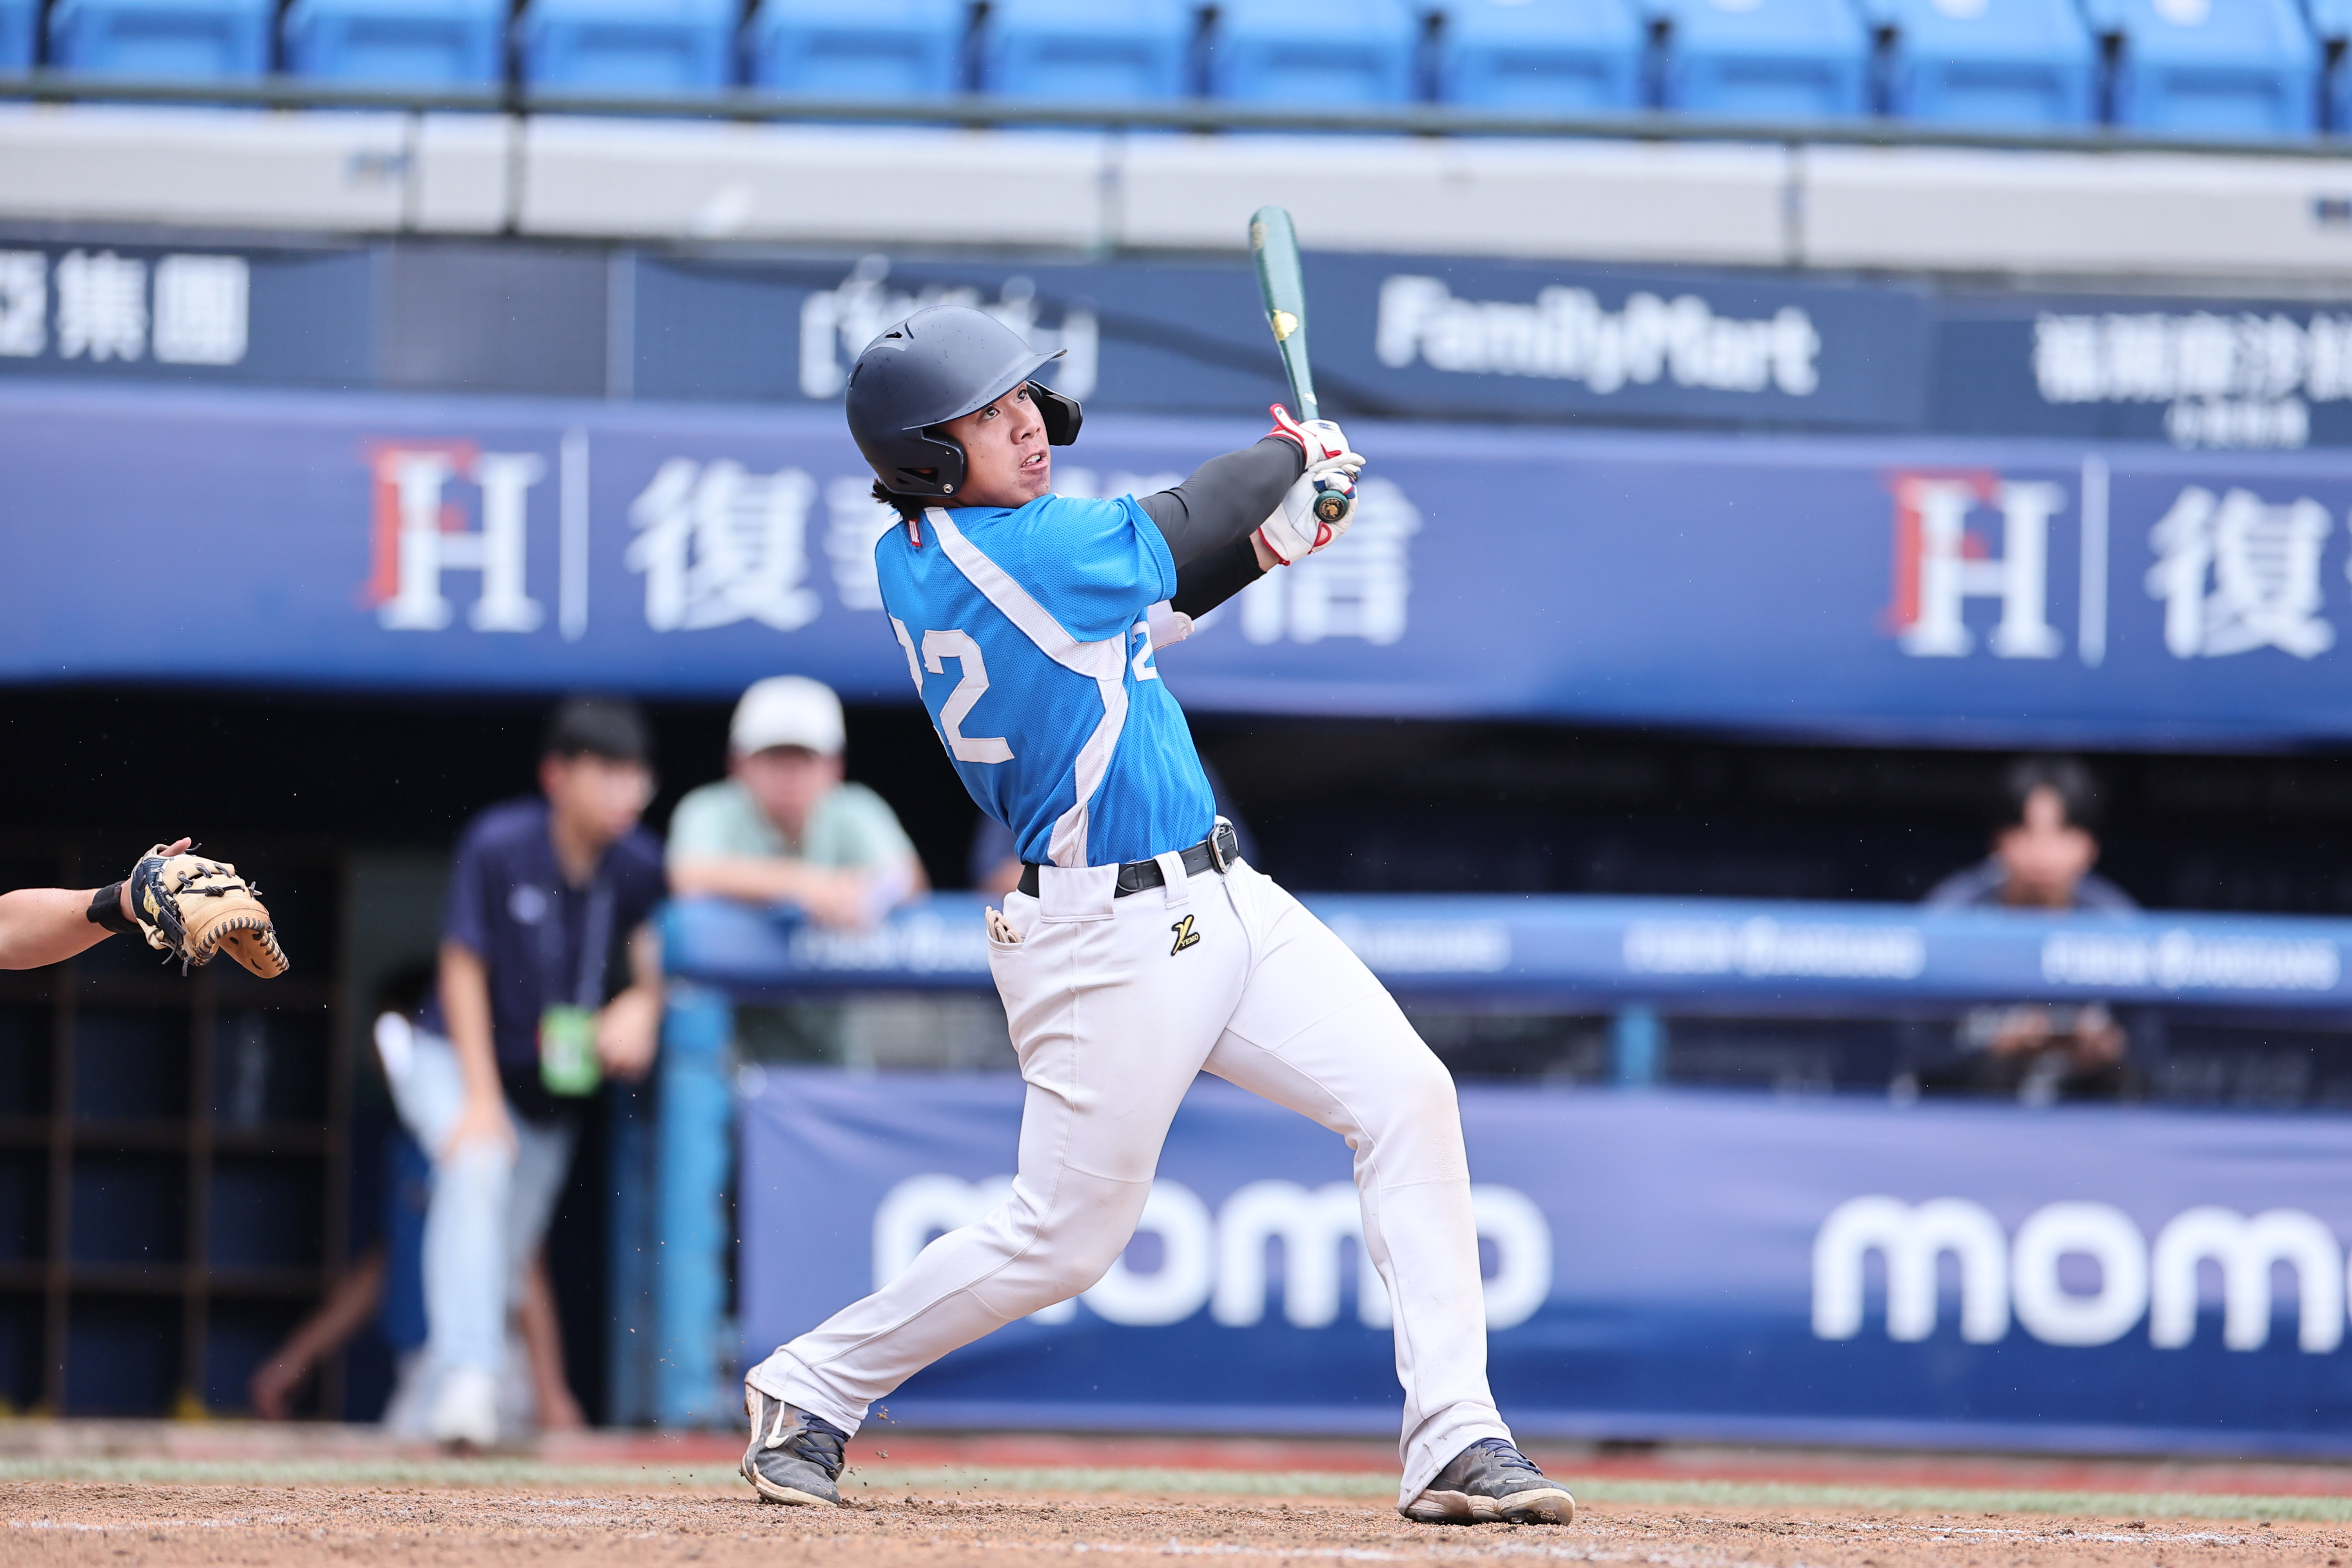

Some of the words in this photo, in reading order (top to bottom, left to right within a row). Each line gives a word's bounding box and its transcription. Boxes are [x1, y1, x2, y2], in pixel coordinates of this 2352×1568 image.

[1375, 274, 1820, 395] FamilyMart
[2144, 485, 2352, 659] 復
[889, 613, 1014, 764] 2
[1181, 934, 1199, 947] YEMO
[1811, 1194, 2352, 1354] mom
